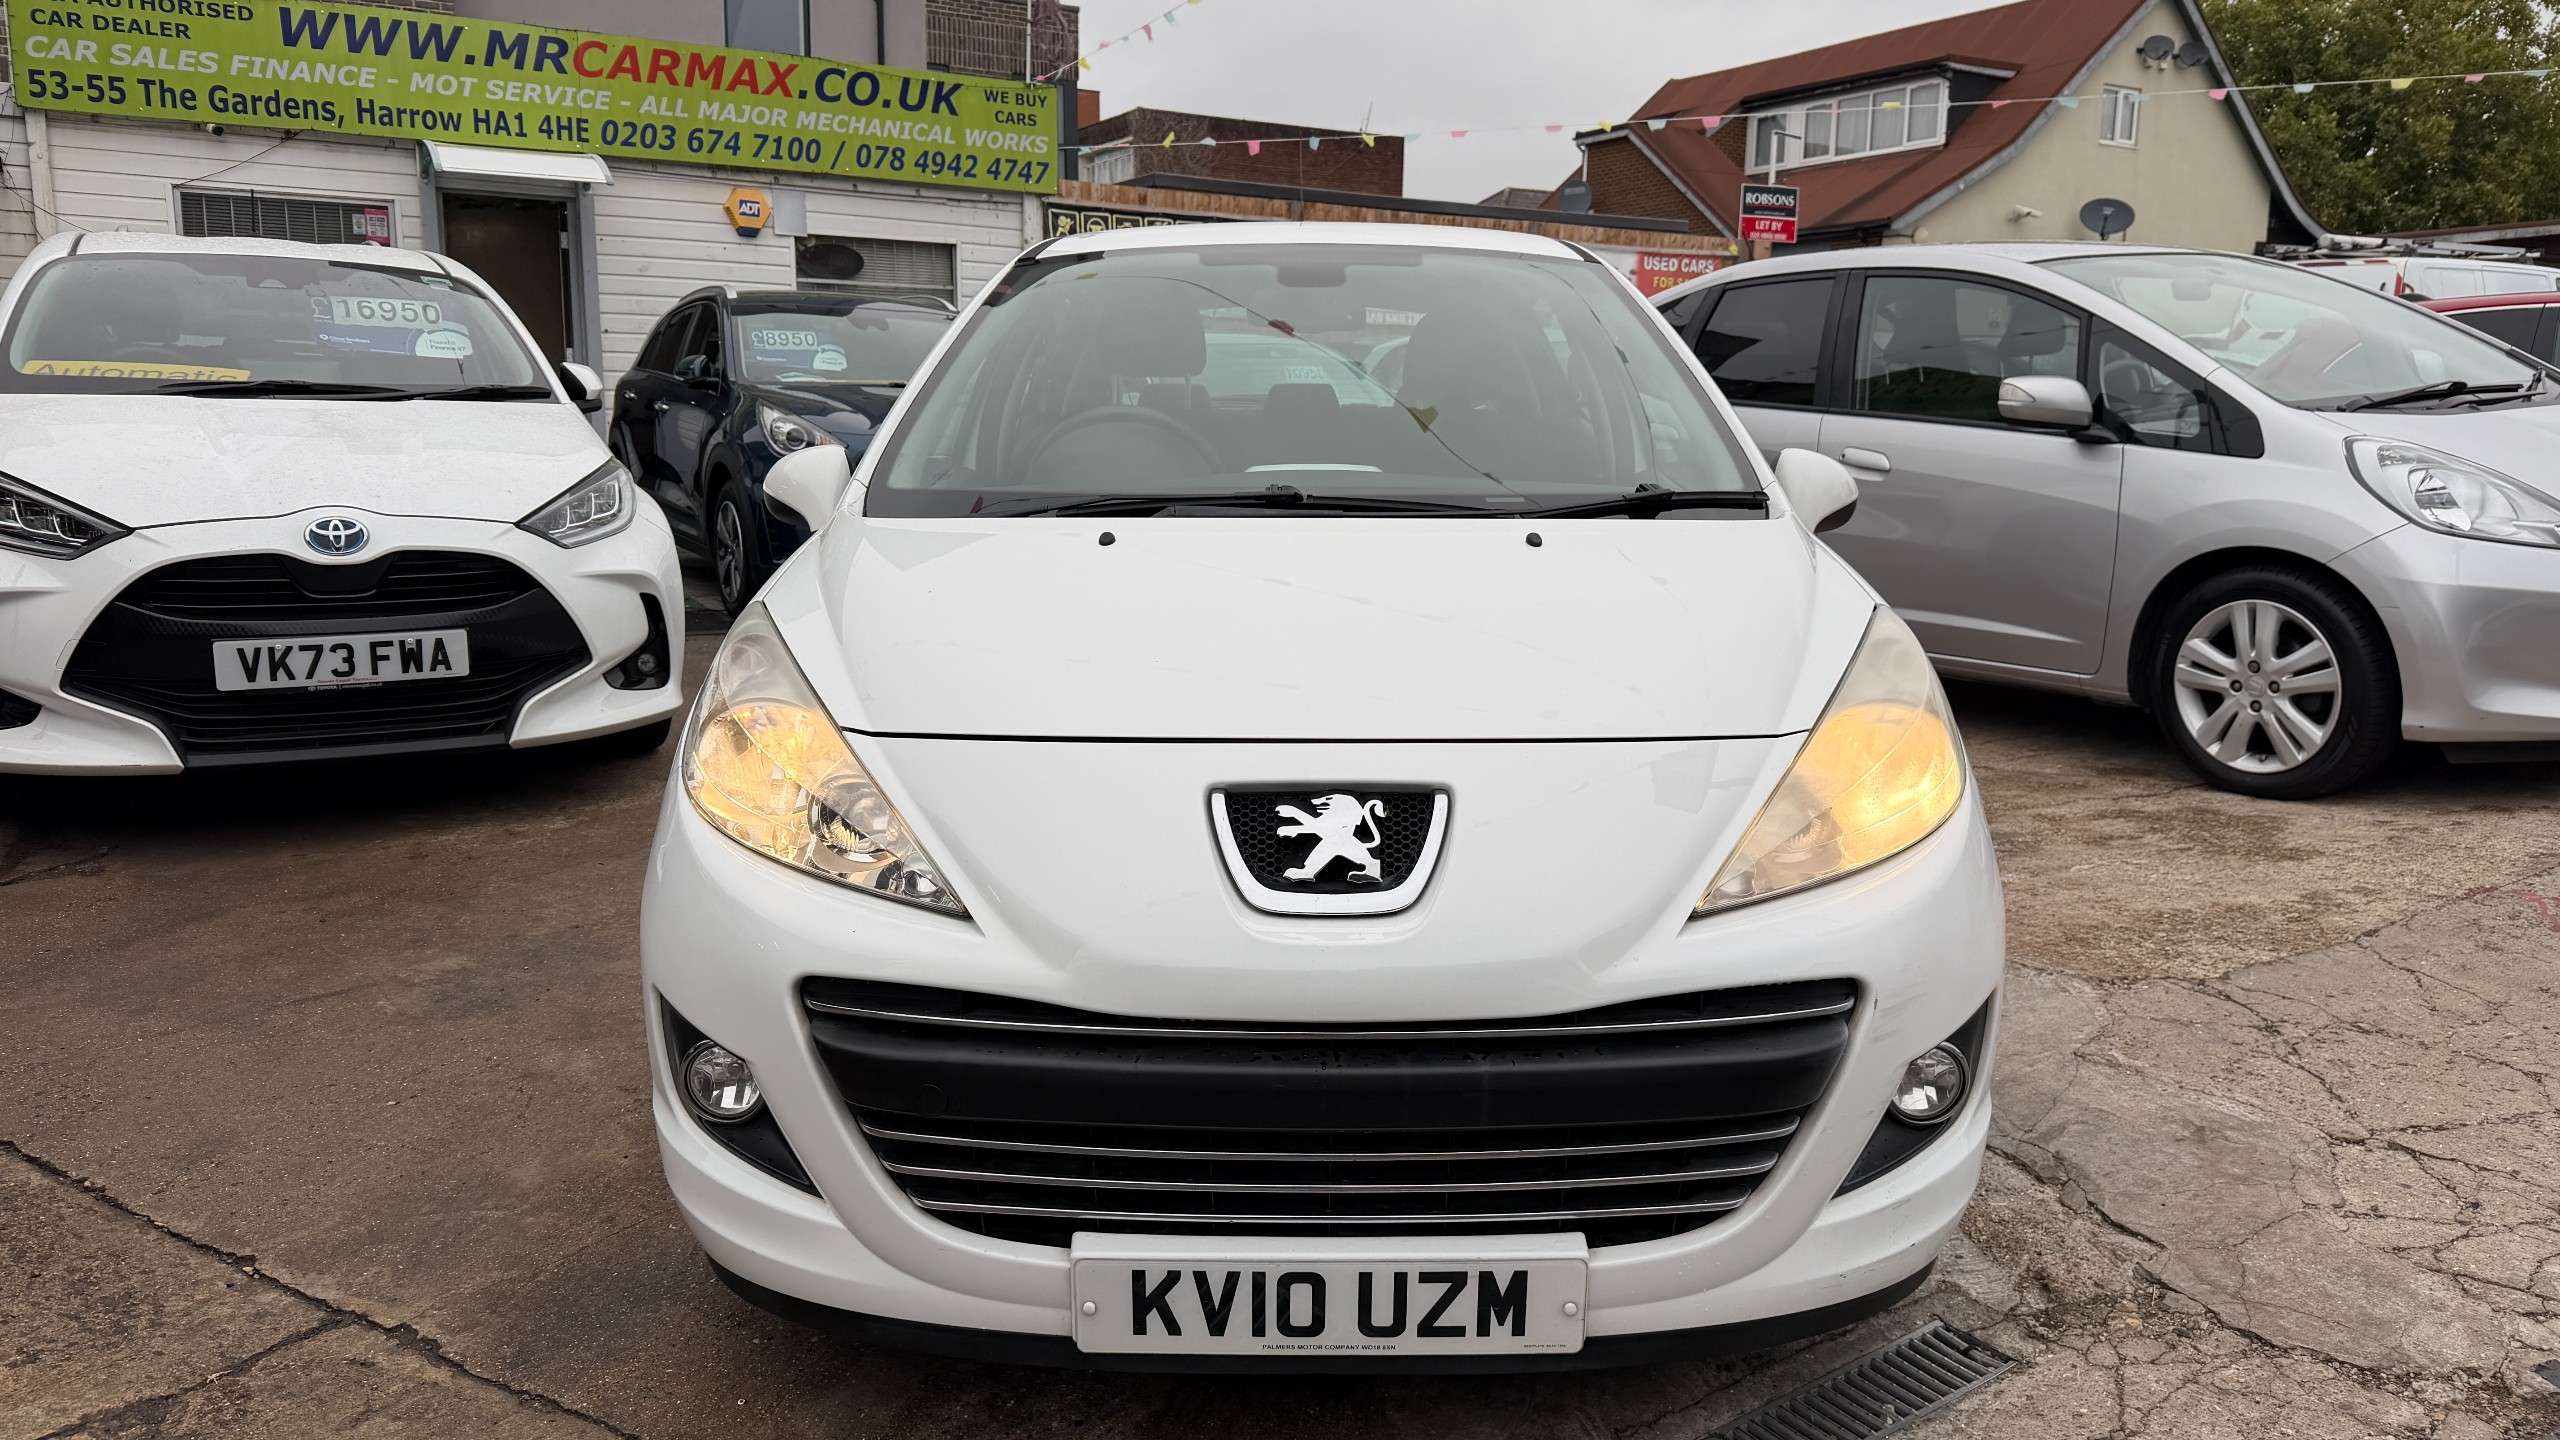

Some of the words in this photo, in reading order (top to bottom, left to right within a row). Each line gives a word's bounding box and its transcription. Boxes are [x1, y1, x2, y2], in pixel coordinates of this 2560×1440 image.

[30, 8, 84, 29] CAR
[92, 14, 192, 39] DEALER
[278, 6, 963, 116] WWW.MRCARMAX.CO.UK
[24, 35, 98, 63] CAR
[109, 43, 219, 74] SALES
[229, 54, 377, 88] FINANCE
[409, 72, 479, 97] MOT
[485, 79, 611, 110] SERVICE
[639, 95, 689, 118] ALL
[698, 100, 789, 128] MAJOR
[796, 110, 956, 145] MECHANICAL
[965, 128, 1049, 154] WORKS
[984, 89, 1009, 105] WE
[1015, 93, 1048, 109] BUY
[27, 68, 127, 105] 53-55
[136, 77, 198, 111] The
[207, 84, 345, 129] Gardens,
[356, 97, 462, 132] Harrow
[472, 107, 528, 138] HA1
[538, 114, 590, 143] 4HE
[601, 119, 676, 150] 0203
[687, 127, 741, 156] 674
[752, 133, 822, 164] 7100
[830, 140, 847, 170] /
[855, 143, 906, 172] 078
[914, 149, 979, 179] 4942
[986, 157, 1050, 185] 4747
[994, 110, 1037, 127] CARS
[740, 202, 760, 216] ADT
[1745, 192, 1795, 207] ROBSONS
[1755, 219, 1770, 230] LET
[1643, 255, 1678, 272] USED
[1681, 258, 1714, 273] CARS
[1653, 276, 1674, 288] FOR
[236, 641, 356, 683] VK73
[369, 637, 453, 676] FWA
[1131, 1269, 1327, 1338] KV10
[1357, 1269, 1530, 1338] UZM
